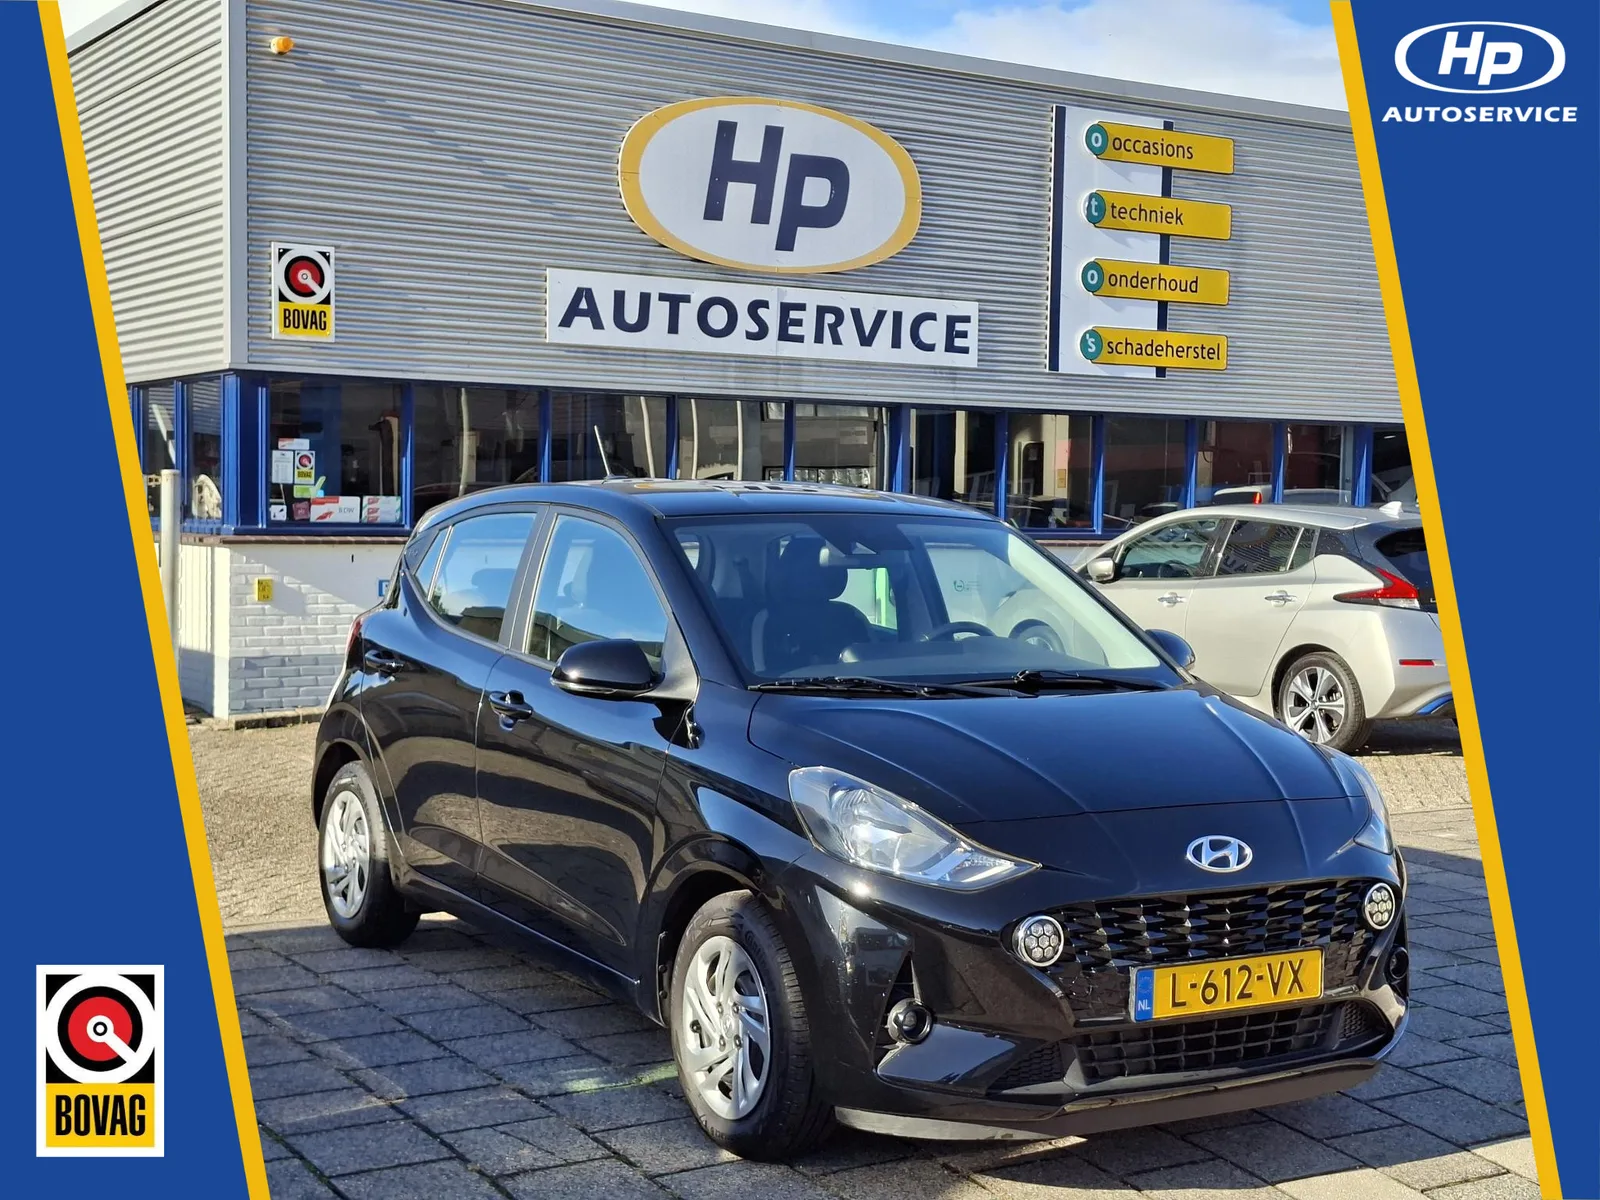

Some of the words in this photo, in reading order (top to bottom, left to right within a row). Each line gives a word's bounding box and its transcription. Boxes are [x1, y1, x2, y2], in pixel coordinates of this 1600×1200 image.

[1112, 135, 1193, 160] occasions
[703, 119, 851, 252] Hp
[1110, 202, 1184, 226] techniek
[1108, 271, 1198, 293] onderhoud
[283, 308, 327, 331] BOVAG
[558, 286, 971, 354] AUTOSERVICE
[1107, 337, 1221, 361] schadeherstel
[1171, 959, 1304, 1008] L-612-VX
[1138, 1001, 1150, 1012] NL
